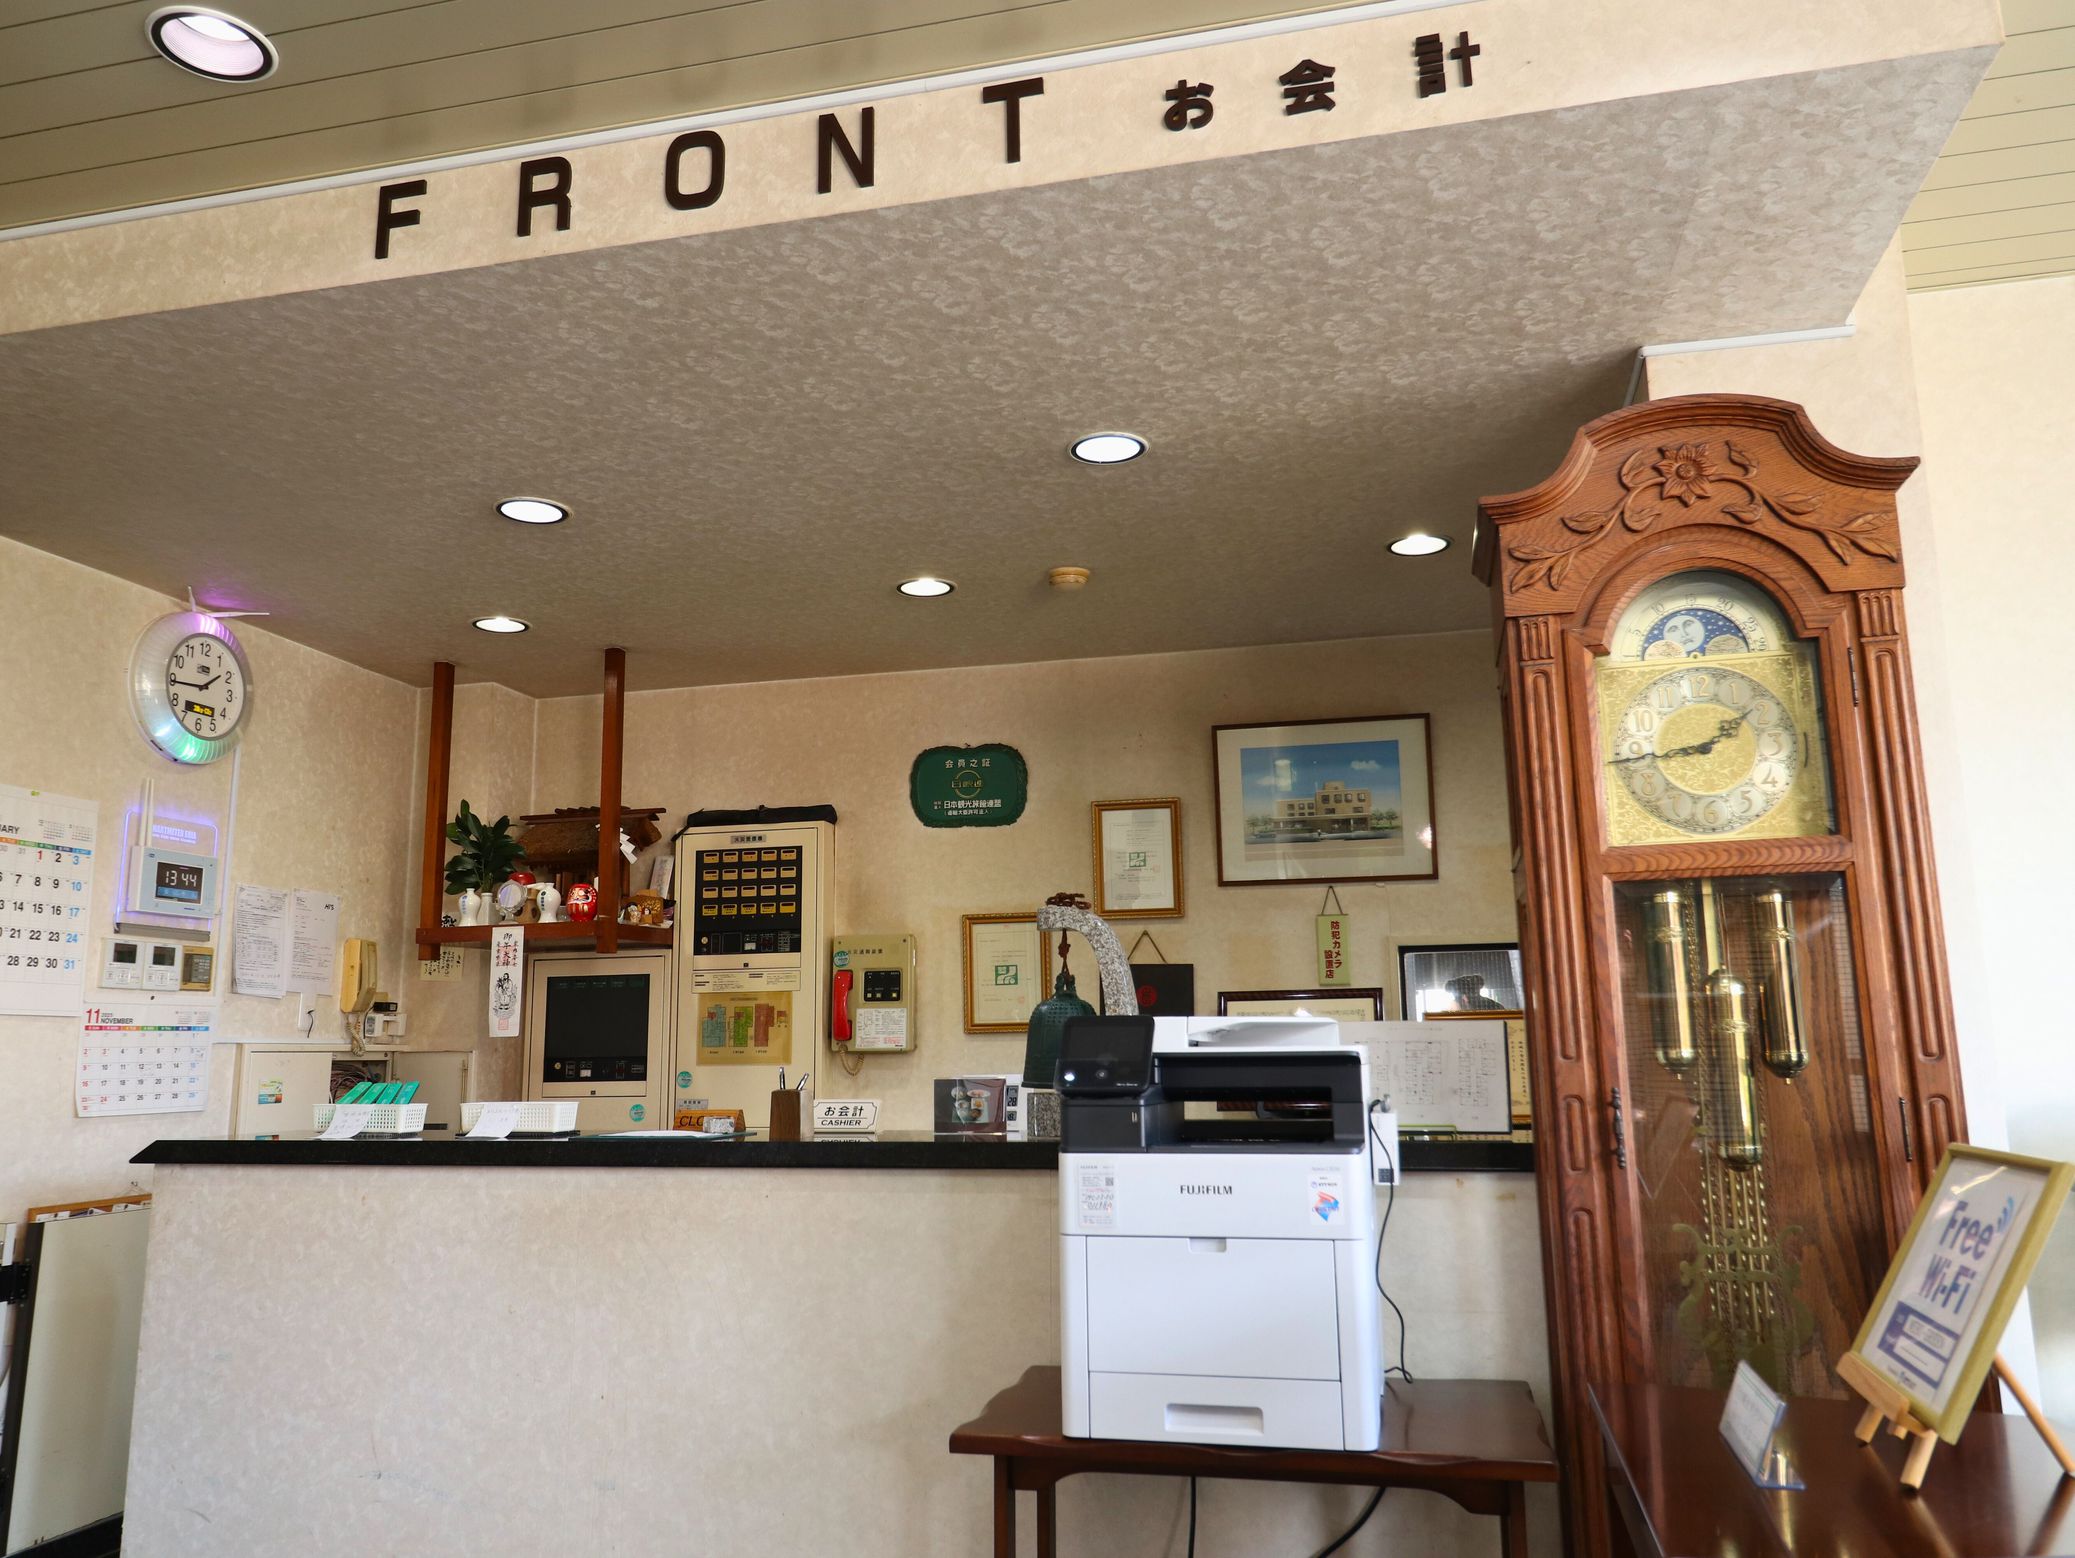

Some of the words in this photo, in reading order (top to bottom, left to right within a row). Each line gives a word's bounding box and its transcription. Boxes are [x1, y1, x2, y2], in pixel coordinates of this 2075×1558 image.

[1164, 31, 1481, 132] お会計
[375, 76, 1045, 260] FRONT
[1717, 596, 1734, 612] 20
[1742, 615, 1758, 632] 25
[186, 644, 194, 658] 11
[200, 643, 211, 657] 12
[174, 655, 184, 668] 10
[218, 656, 221, 667] 1
[170, 673, 176, 686] 9
[225, 671, 232, 684] 2
[1690, 675, 1711, 698] 12
[1729, 681, 1739, 704] 1
[172, 693, 178, 706] 8
[226, 690, 232, 702] 3
[1657, 686, 1674, 709] 11
[181, 710, 188, 722] 7
[220, 708, 226, 720] 4
[1633, 710, 1654, 733] 10
[1755, 703, 1769, 725] 2
[195, 718, 202, 731] 6
[210, 719, 216, 731] 5
[1767, 735, 1782, 757] 3
[1761, 768, 1778, 788] 4
[1740, 790, 1754, 813] 5
[1703, 800, 1720, 824] 6
[55, 853, 62, 863] 2
[72, 855, 80, 865] 3
[15, 874, 22, 884] 7
[34, 876, 41, 887] 8
[52, 879, 60, 889] 9
[71, 881, 82, 891] 10
[13, 901, 24, 912] 14
[33, 903, 44, 914] 15
[51, 905, 62, 916] 16
[69, 907, 80, 917] 17
[9, 928, 21, 939] 21
[29, 930, 41, 941] 22
[48, 931, 60, 942] 23
[65, 933, 78, 943] 24
[1330, 920, 1343, 969] 防犯カメラ
[7, 955, 20, 966] 28
[26, 957, 39, 967] 29
[45, 958, 58, 968] 30
[63, 959, 75, 969] 31
[1323, 949, 1335, 979] 設置店
[86, 1008, 100, 1024] 11
[824, 1105, 864, 1117] お会計
[1180, 1184, 1232, 1195] FUJIFILM
[1939, 1200, 1994, 1260] Free
[1918, 1253, 1977, 1314] Wi-Fi
